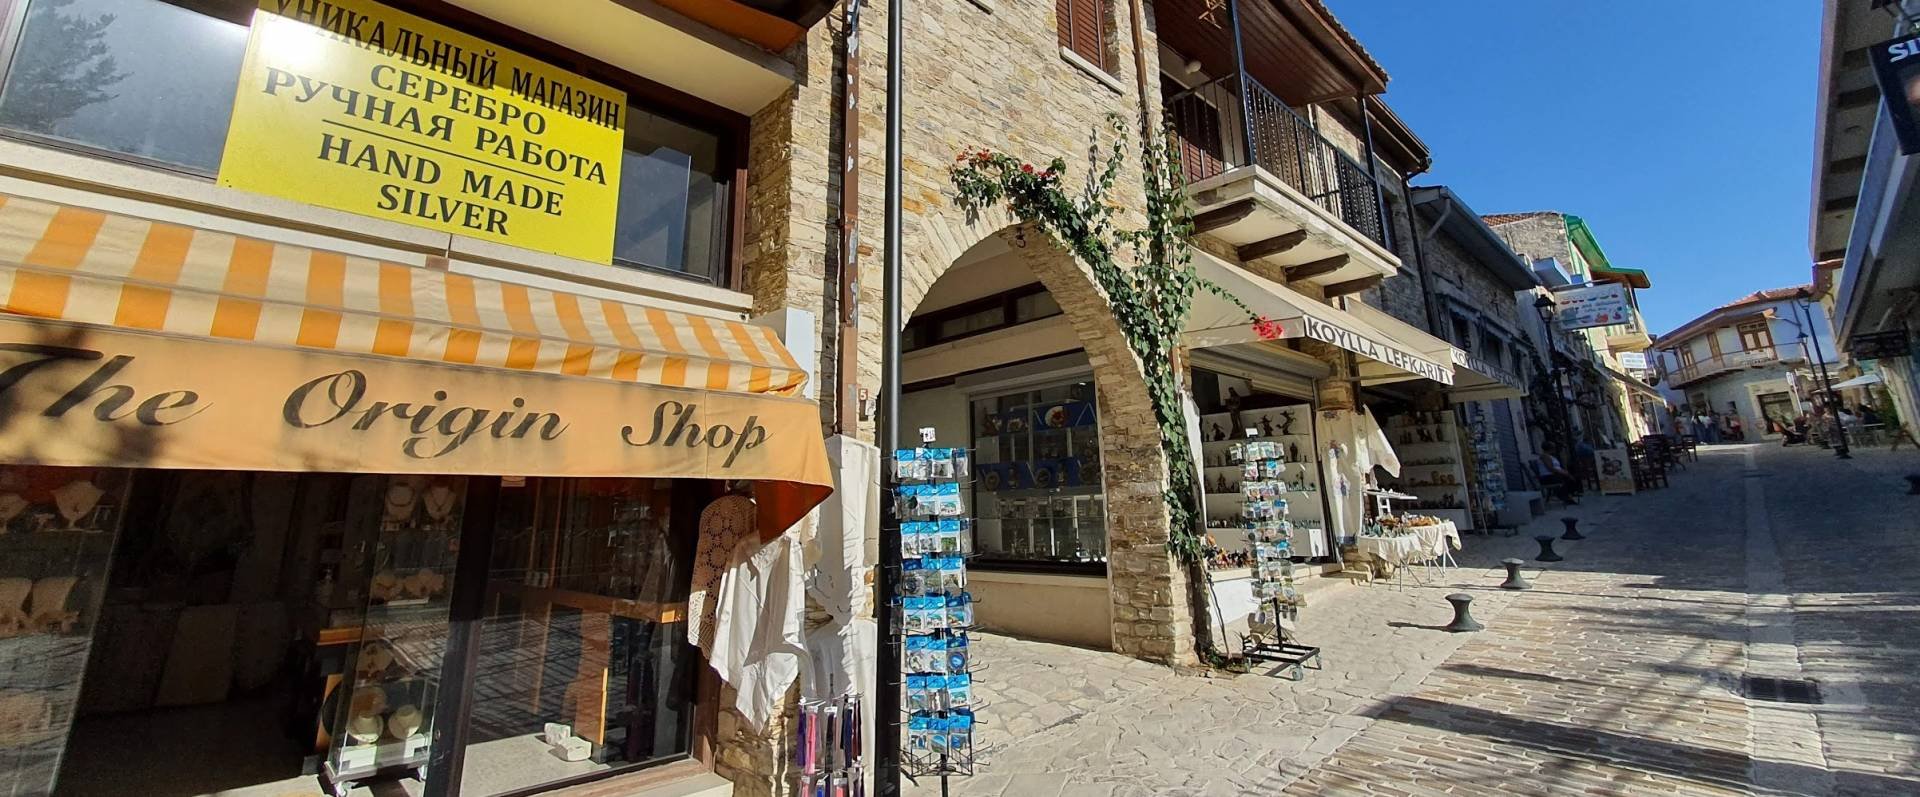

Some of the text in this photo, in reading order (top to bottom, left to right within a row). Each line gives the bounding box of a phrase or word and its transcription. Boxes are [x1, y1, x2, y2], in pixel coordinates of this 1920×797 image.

[1888, 37, 1920, 62] SI
[262, 66, 607, 185] РУЧНАЯ РАБОТА
[371, 64, 546, 135] СЕРЕБРО
[510, 67, 620, 131] МАГАЗИН
[317, 133, 564, 216] HAND MADE
[377, 184, 509, 235] SILVER
[1307, 317, 1379, 360] KOYLLA
[0, 342, 774, 468] The Origin Shop
